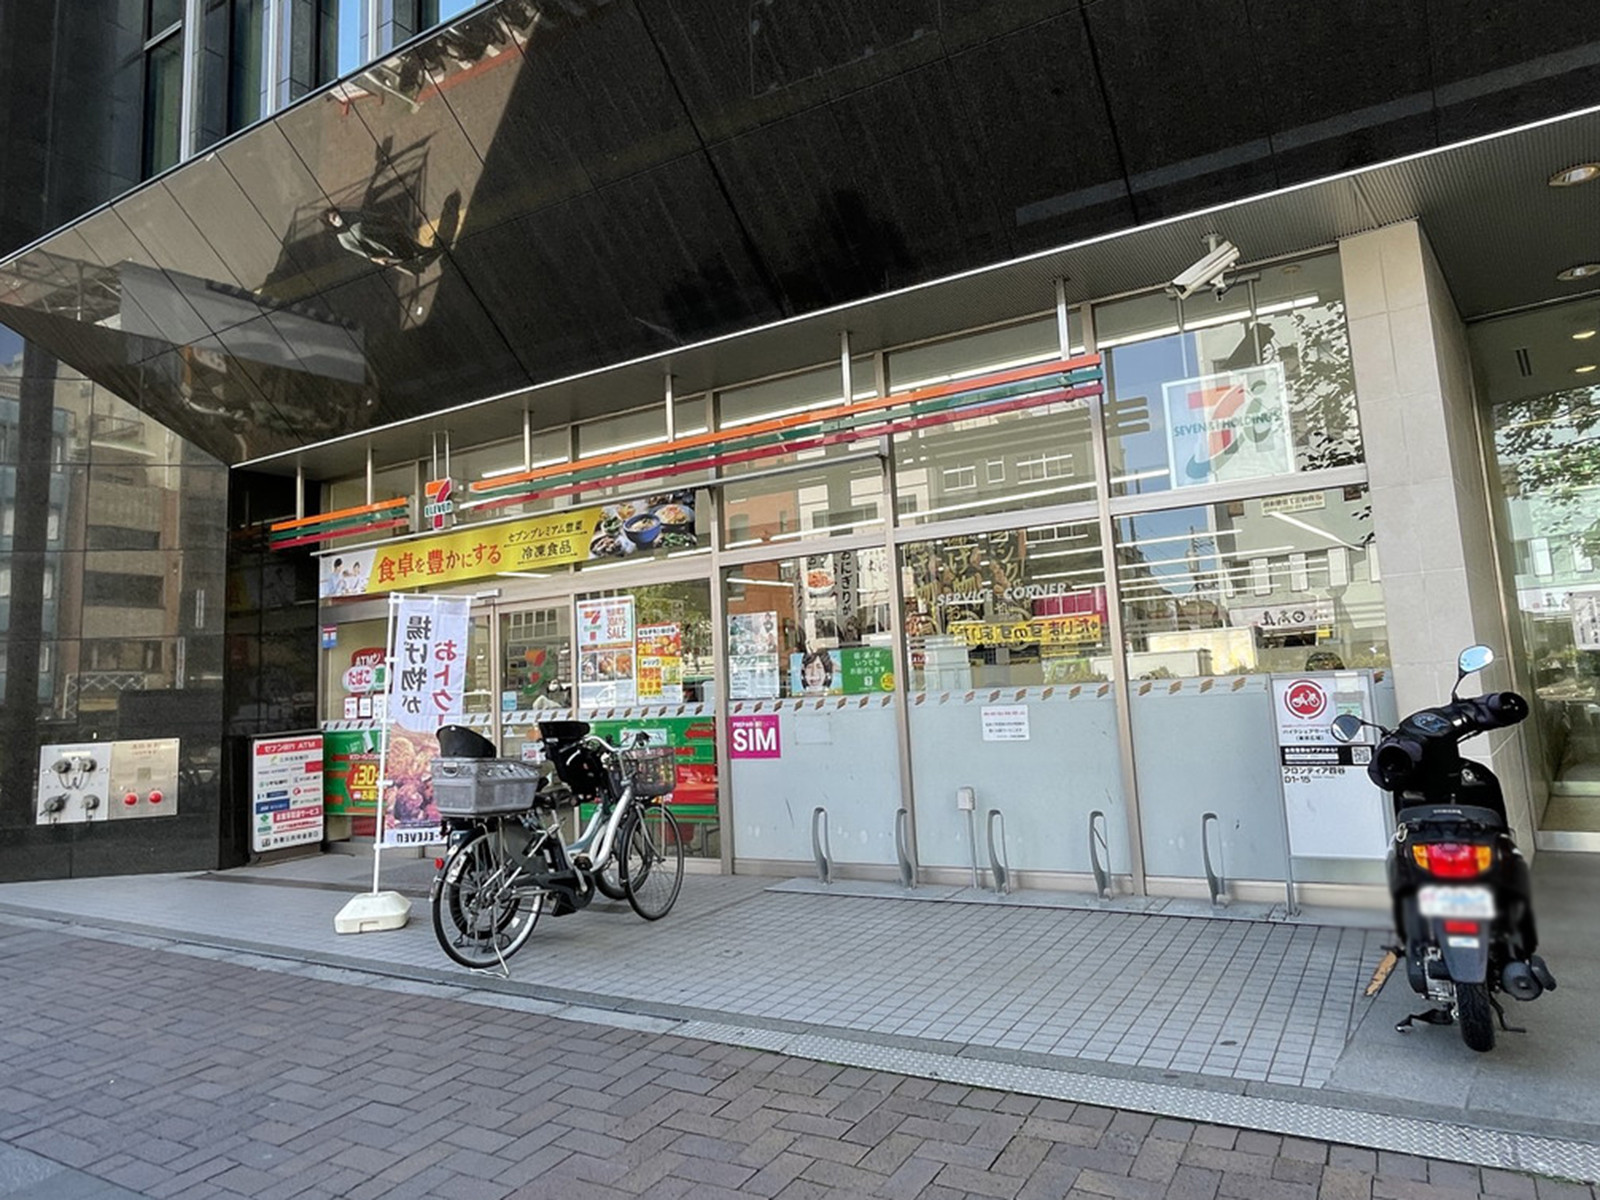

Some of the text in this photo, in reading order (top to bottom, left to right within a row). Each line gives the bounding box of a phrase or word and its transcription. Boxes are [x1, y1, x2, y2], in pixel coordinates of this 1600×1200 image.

[1173, 422, 1206, 437] SEVEN
[508, 520, 583, 543] セブンプレミアム惣菜
[521, 539, 572, 559] 冷凍食品
[378, 542, 501, 584] 食卓を豊かにする
[937, 582, 1066, 607] SERVICE CORNER
[348, 669, 371, 686] たばこ
[732, 727, 777, 752] SIM
